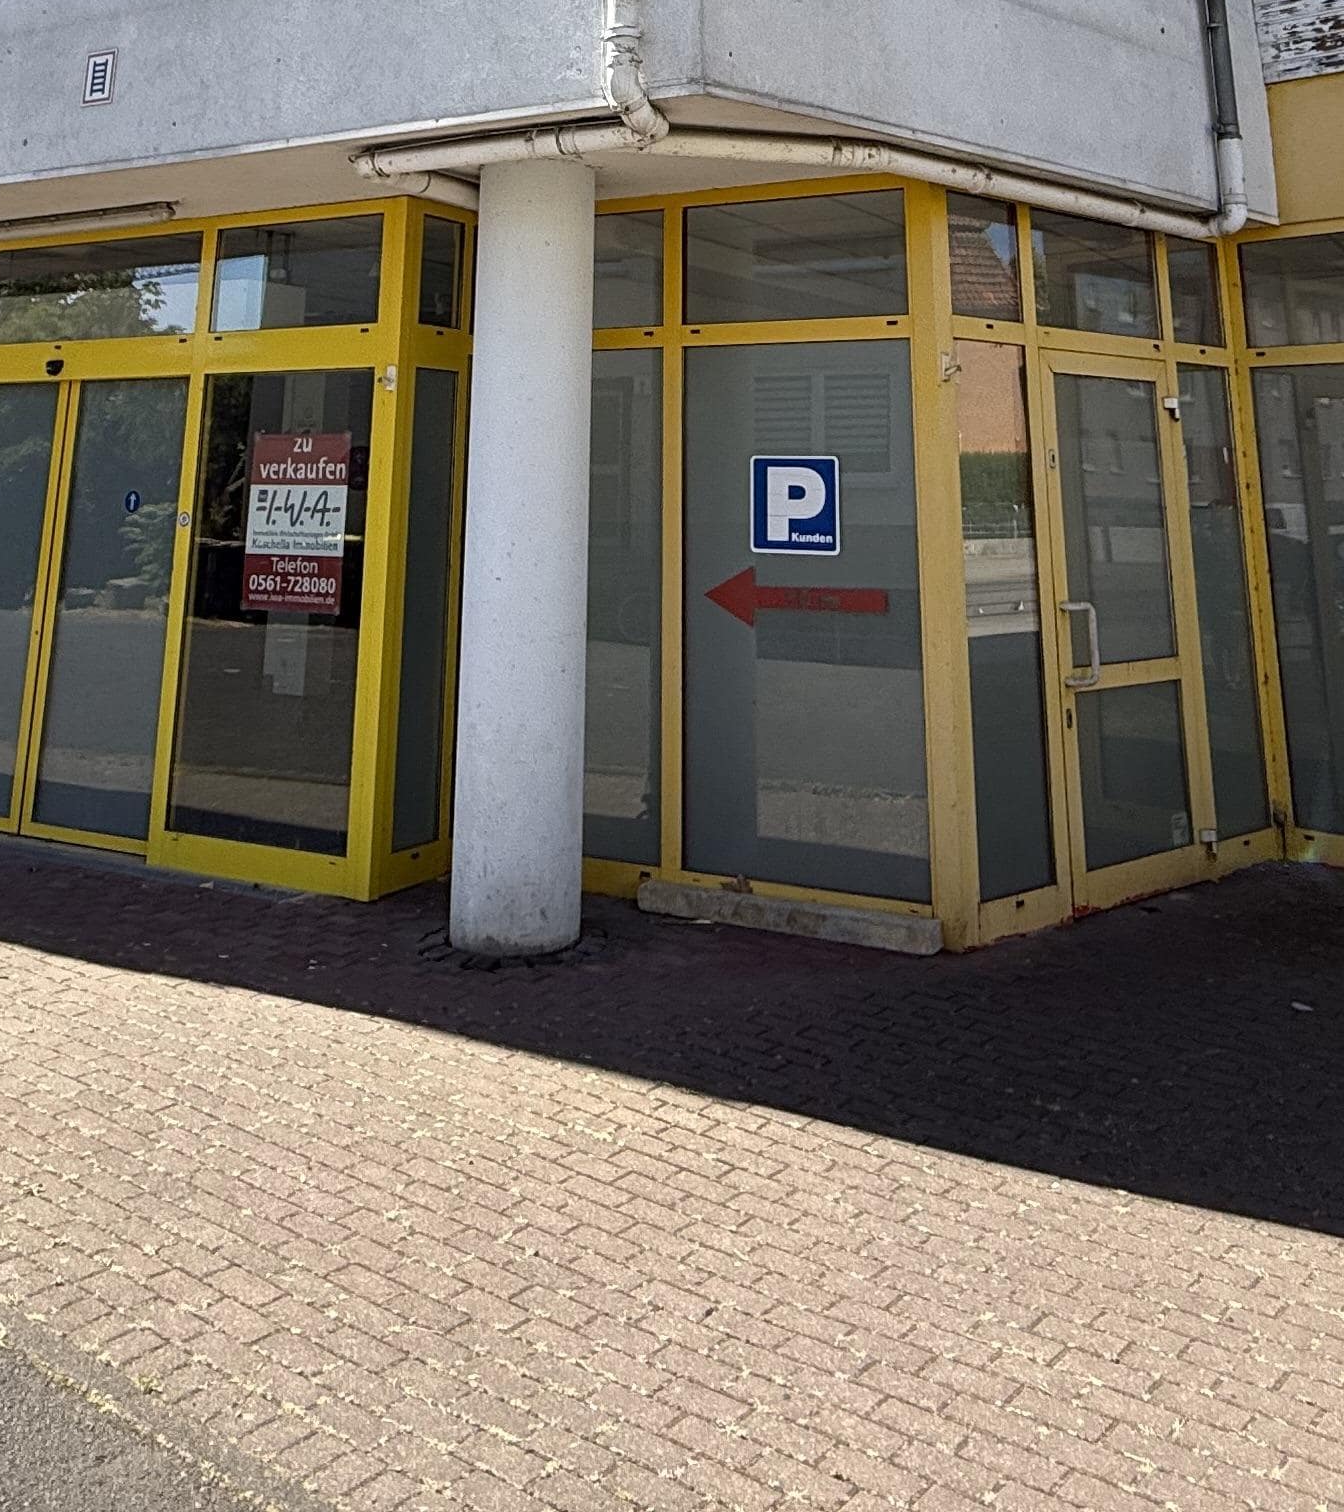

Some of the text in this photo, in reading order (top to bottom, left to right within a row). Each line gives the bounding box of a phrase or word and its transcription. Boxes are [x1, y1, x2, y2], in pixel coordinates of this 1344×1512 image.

[293, 438, 313, 453] zu
[259, 457, 346, 480] verkaufen
[767, 466, 826, 541] P
[791, 532, 833, 544] Kunden
[271, 557, 319, 575] Telefon
[248, 574, 336, 595] 0561-728080
